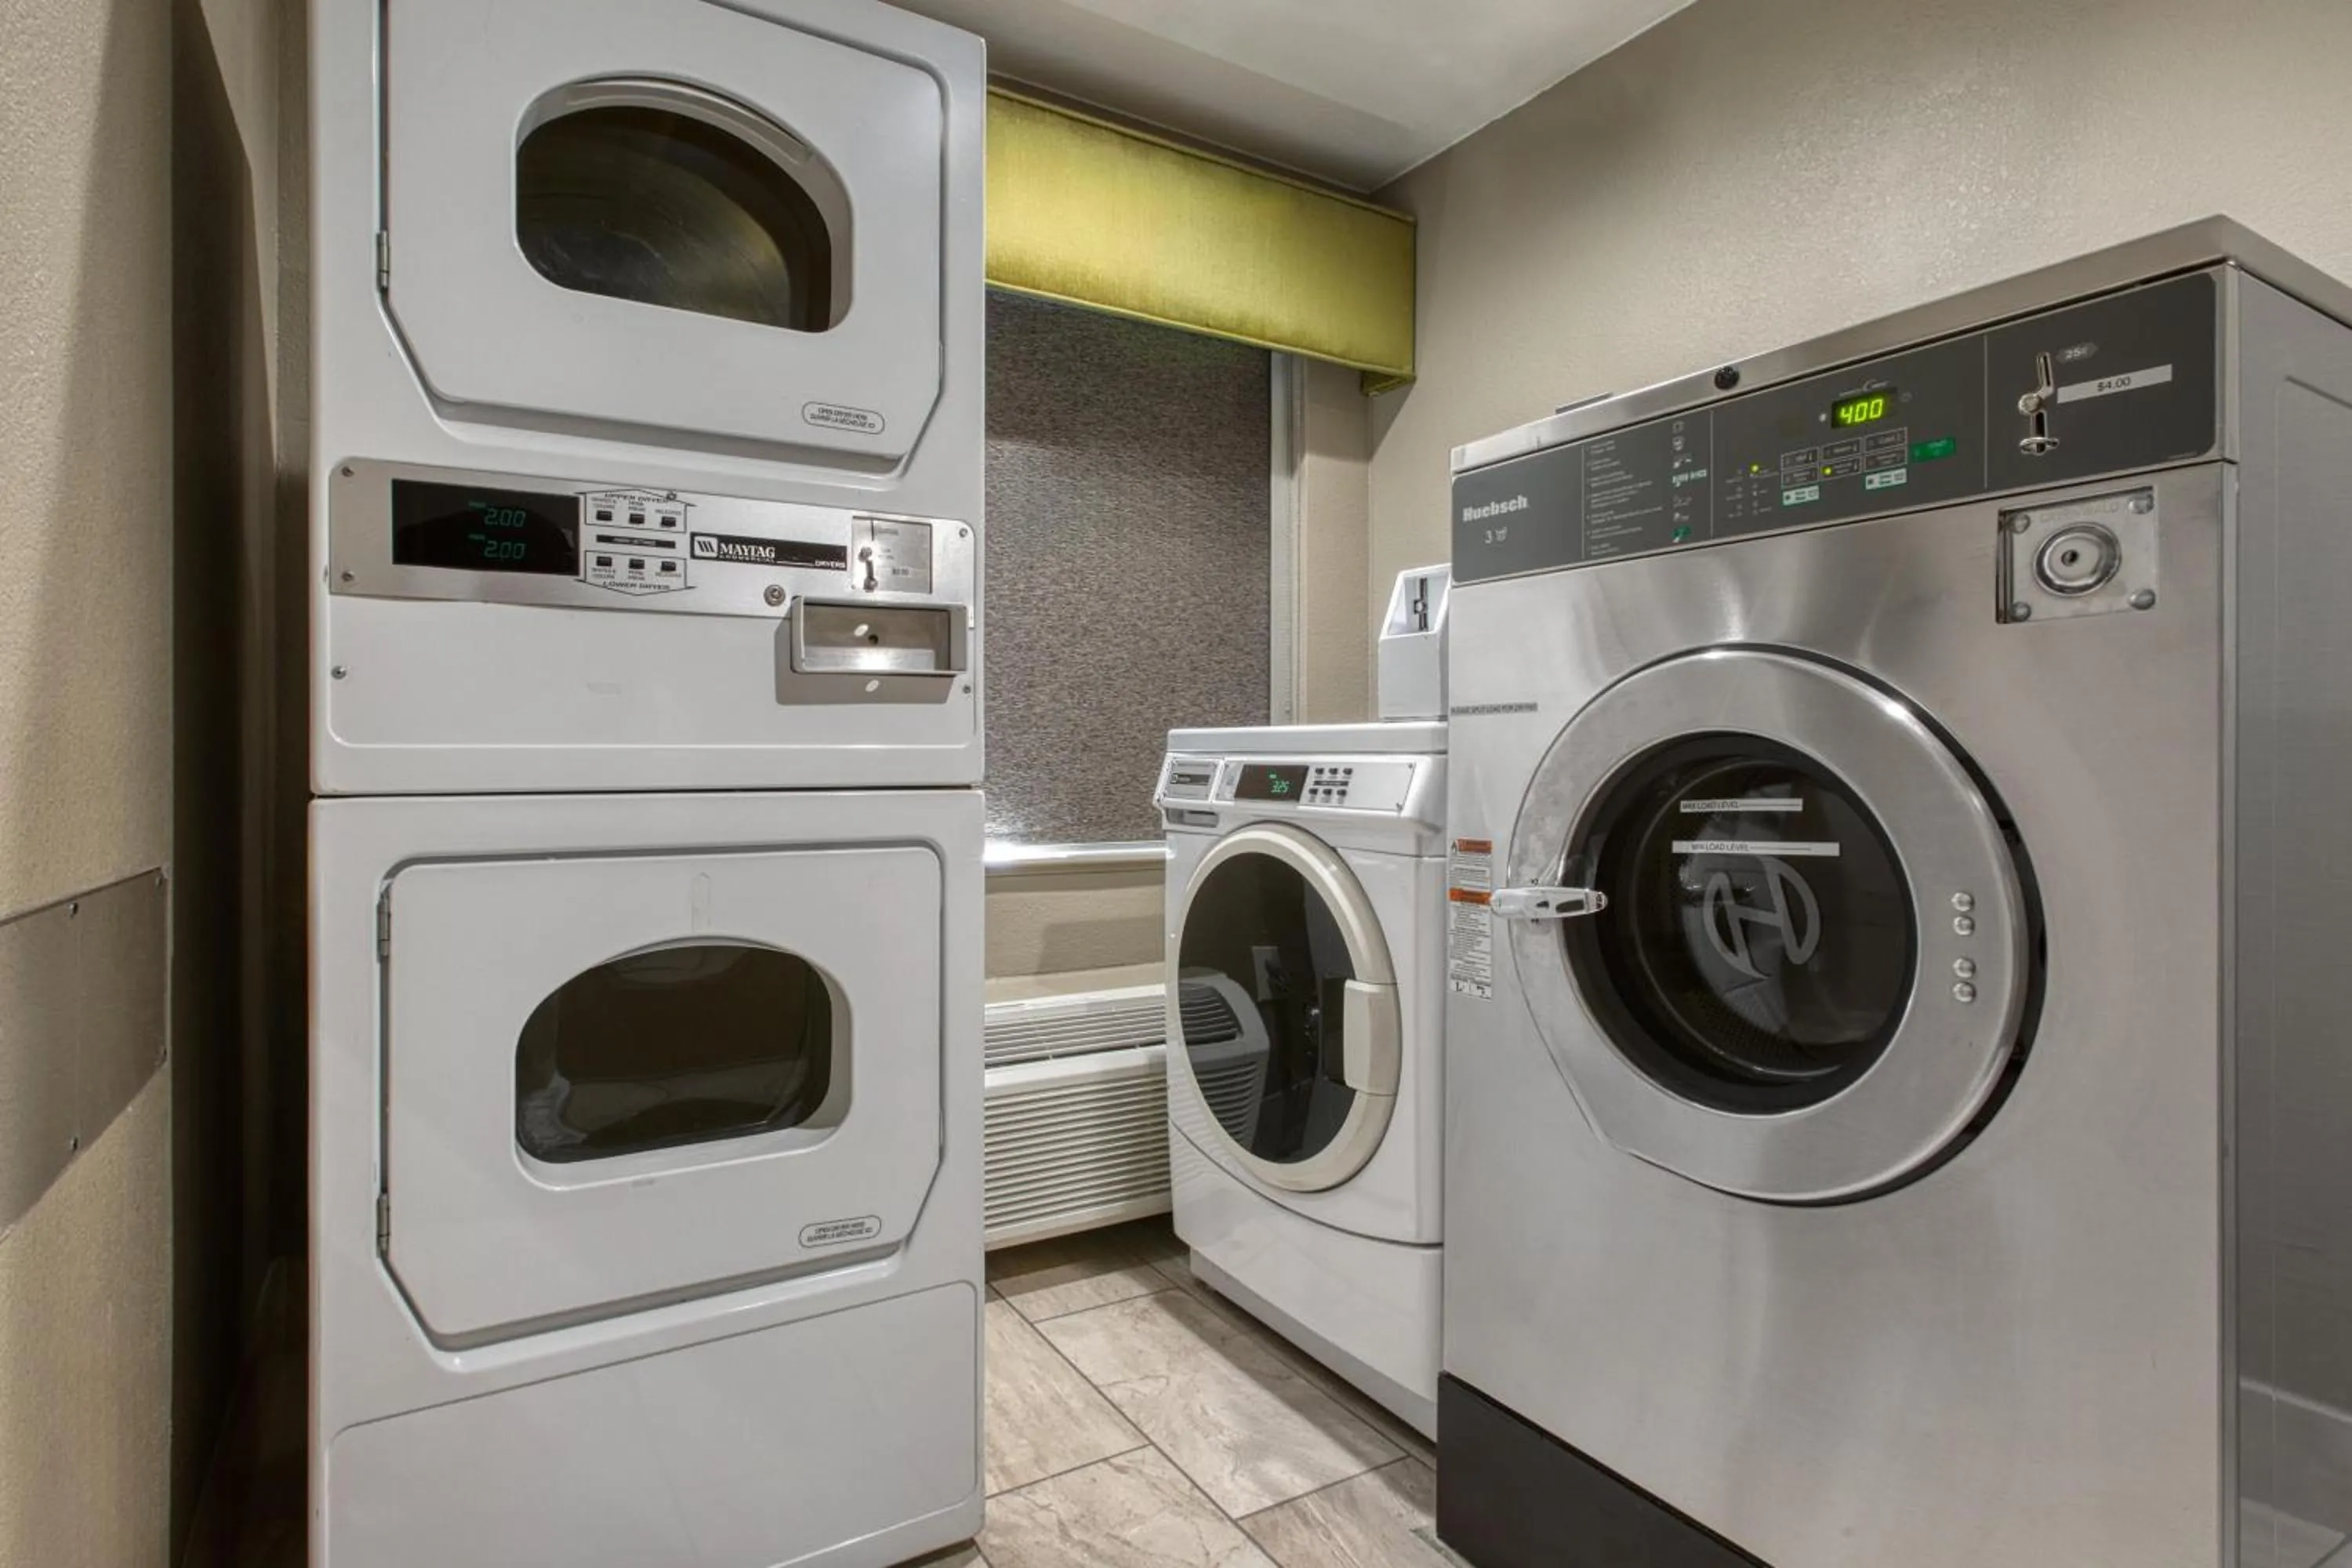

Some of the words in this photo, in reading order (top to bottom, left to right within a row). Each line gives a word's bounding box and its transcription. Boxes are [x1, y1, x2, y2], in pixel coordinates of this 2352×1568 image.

[2097, 376, 2131, 392] $4.00
[1839, 397, 1885, 424] 400
[1462, 495, 1528, 523] Huebsch
[720, 543, 775, 558] MAYTAG
[815, 560, 846, 568] DRYERS
